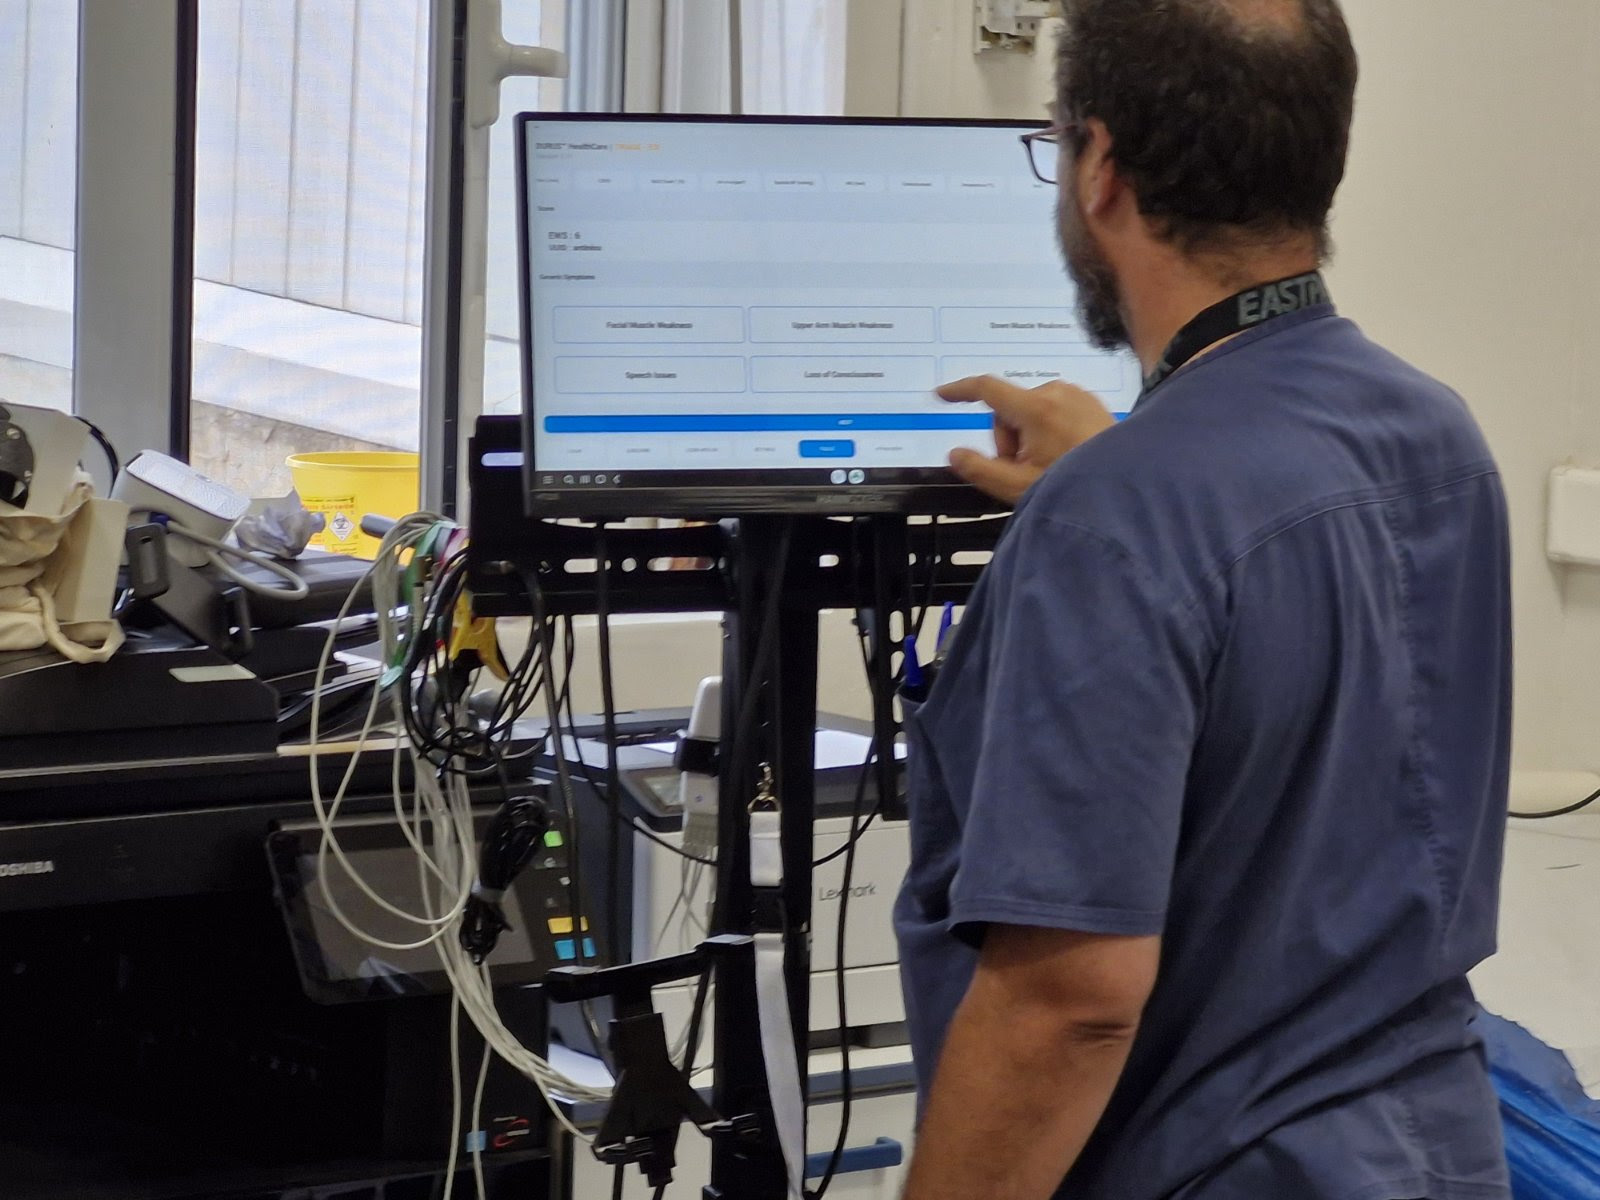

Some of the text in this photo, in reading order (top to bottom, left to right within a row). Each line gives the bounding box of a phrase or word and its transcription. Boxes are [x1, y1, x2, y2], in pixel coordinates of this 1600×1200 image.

[630, 321, 655, 329] Muscle
[657, 321, 693, 329] Weakness
[791, 321, 814, 331] Upper
[832, 321, 857, 329] Muscle
[859, 321, 894, 329] Weakness
[625, 370, 652, 379] Speech
[804, 370, 821, 378] Loss
